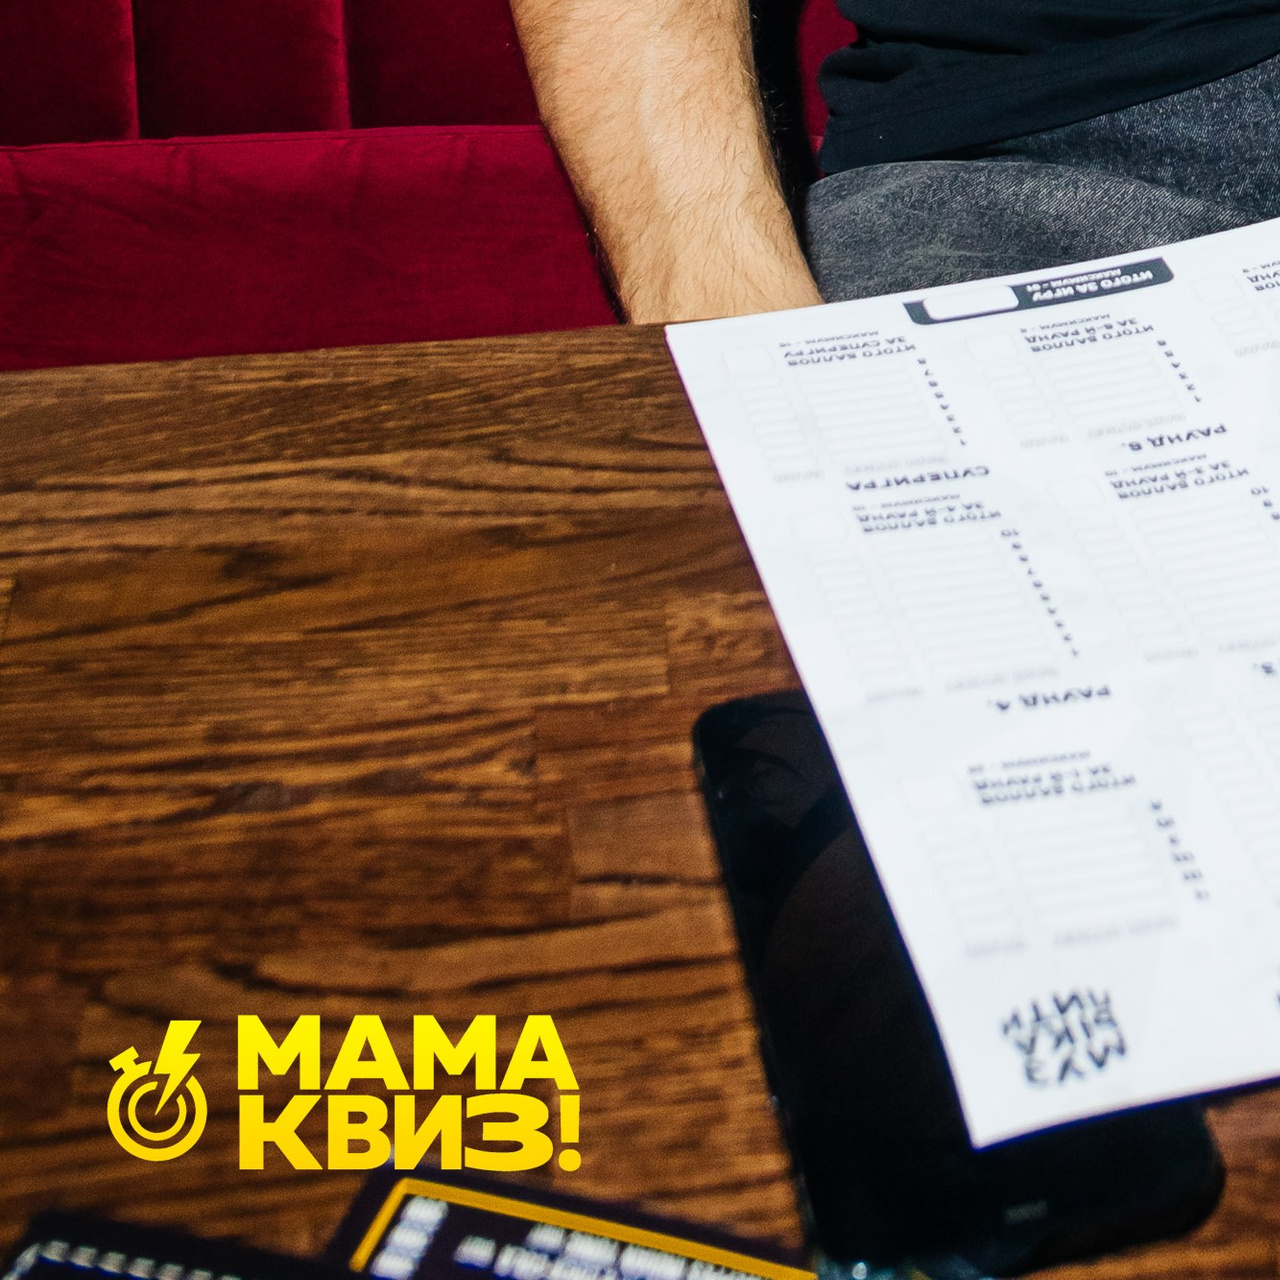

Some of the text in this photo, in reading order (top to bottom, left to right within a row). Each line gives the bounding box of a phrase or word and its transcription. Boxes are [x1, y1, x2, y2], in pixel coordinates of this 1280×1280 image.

[1032, 270, 1153, 302] ИТОГО ЗА ИГРУ
[1050, 268, 1121, 287] МАКСИМУМ
[783, 336, 906, 358] ЗА СУПЕРИГРУ
[1024, 329, 1080, 343] РАУНД
[1030, 325, 1154, 353] ИТОГО БАЛЛОВ
[787, 344, 916, 366] ИТОГО БАЛЛОВ
[1147, 424, 1227, 448] РАУНД
[1209, 460, 1230, 470] ЗА
[846, 466, 990, 491] СУПЕРИГРА
[1110, 473, 1169, 489] РАУНД
[1118, 468, 1249, 500] ИТОГО БАЛЛОВ
[1018, 686, 1110, 707] РАУНД
